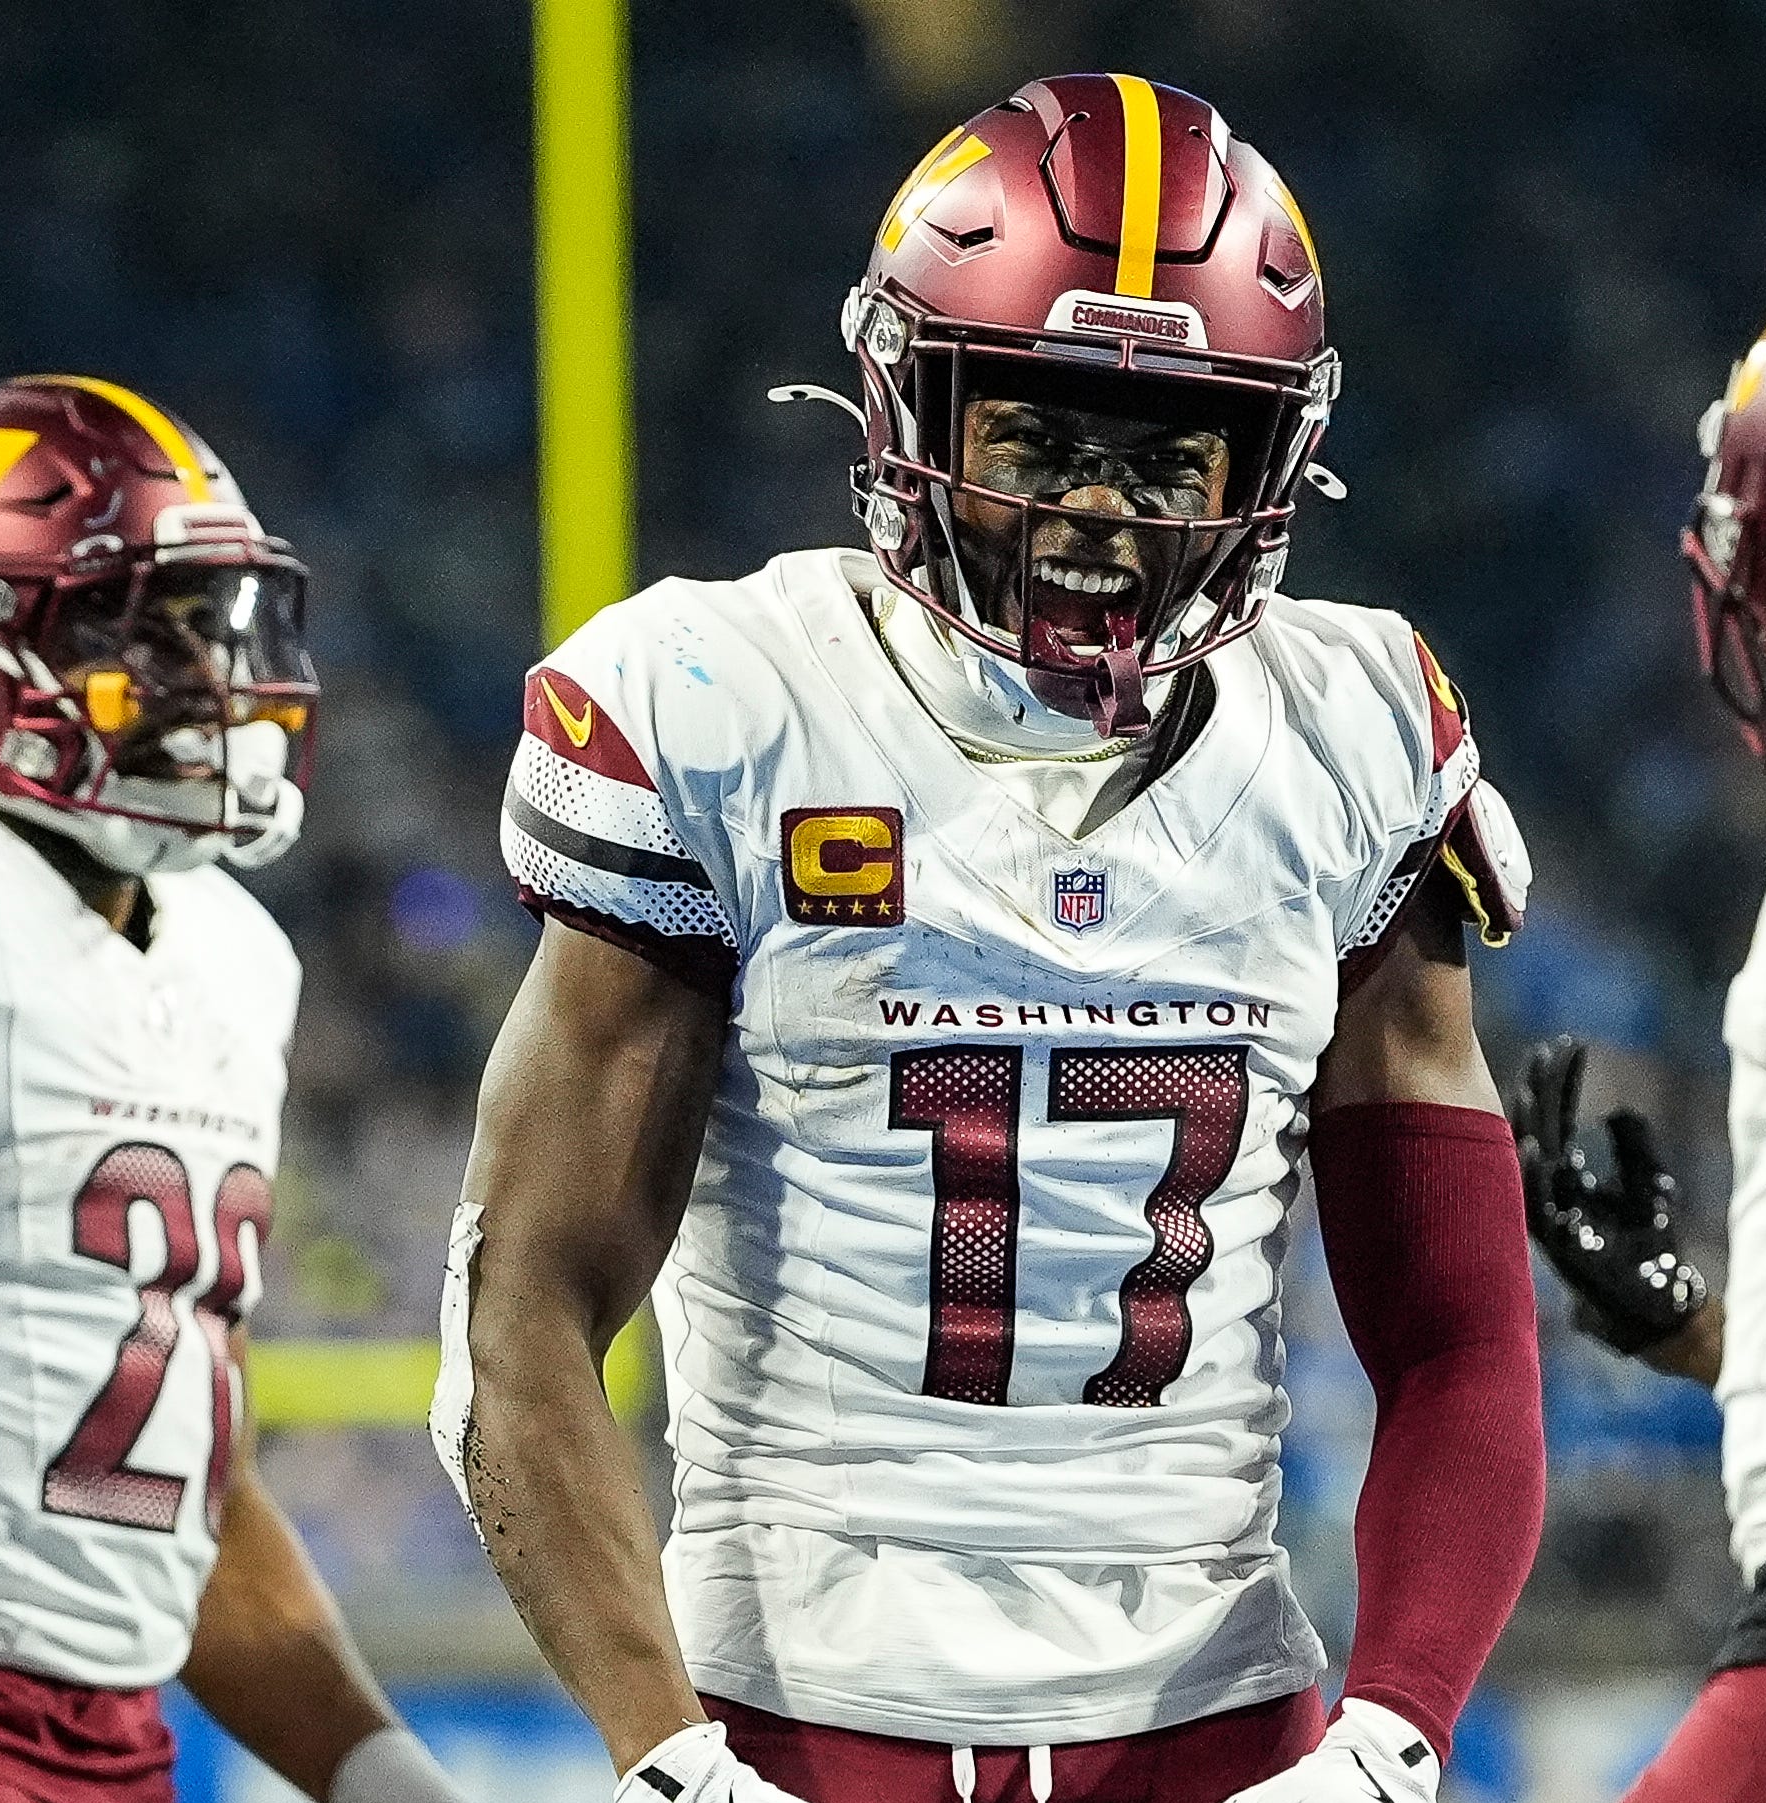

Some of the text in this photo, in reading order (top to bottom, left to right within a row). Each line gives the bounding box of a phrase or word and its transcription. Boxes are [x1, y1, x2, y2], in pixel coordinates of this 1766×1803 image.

[1072, 305, 1190, 340] COMMANDERS
[791, 815, 893, 897] C
[1059, 895, 1100, 925] NFL
[879, 999, 1271, 1029] WASHINGTON
[888, 1042, 1250, 1408] 17
